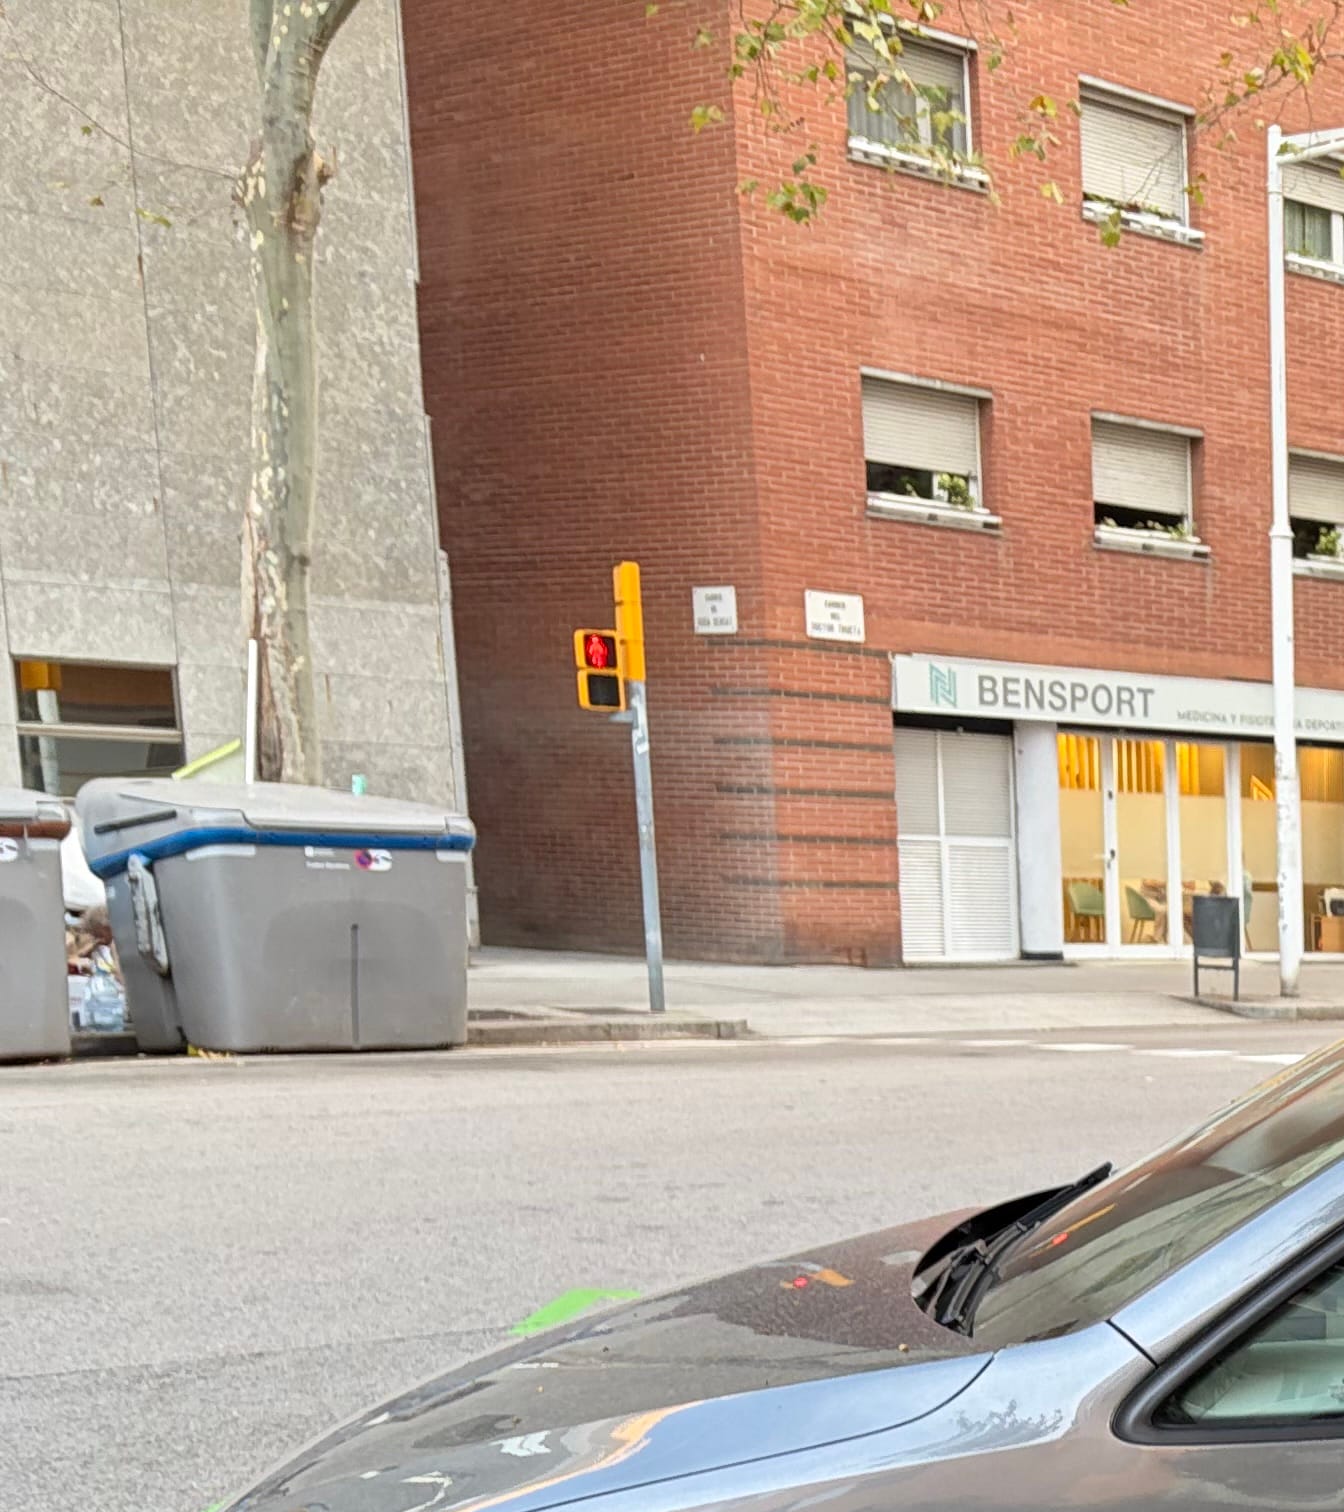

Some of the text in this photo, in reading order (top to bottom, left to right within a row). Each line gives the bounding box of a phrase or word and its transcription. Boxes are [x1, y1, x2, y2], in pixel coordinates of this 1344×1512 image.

[978, 674, 1155, 718] BENSPORT
[1176, 709, 1228, 723] MEDICINA
[1231, 712, 1237, 723] Y
[1239, 713, 1302, 729] FISIOTEA
